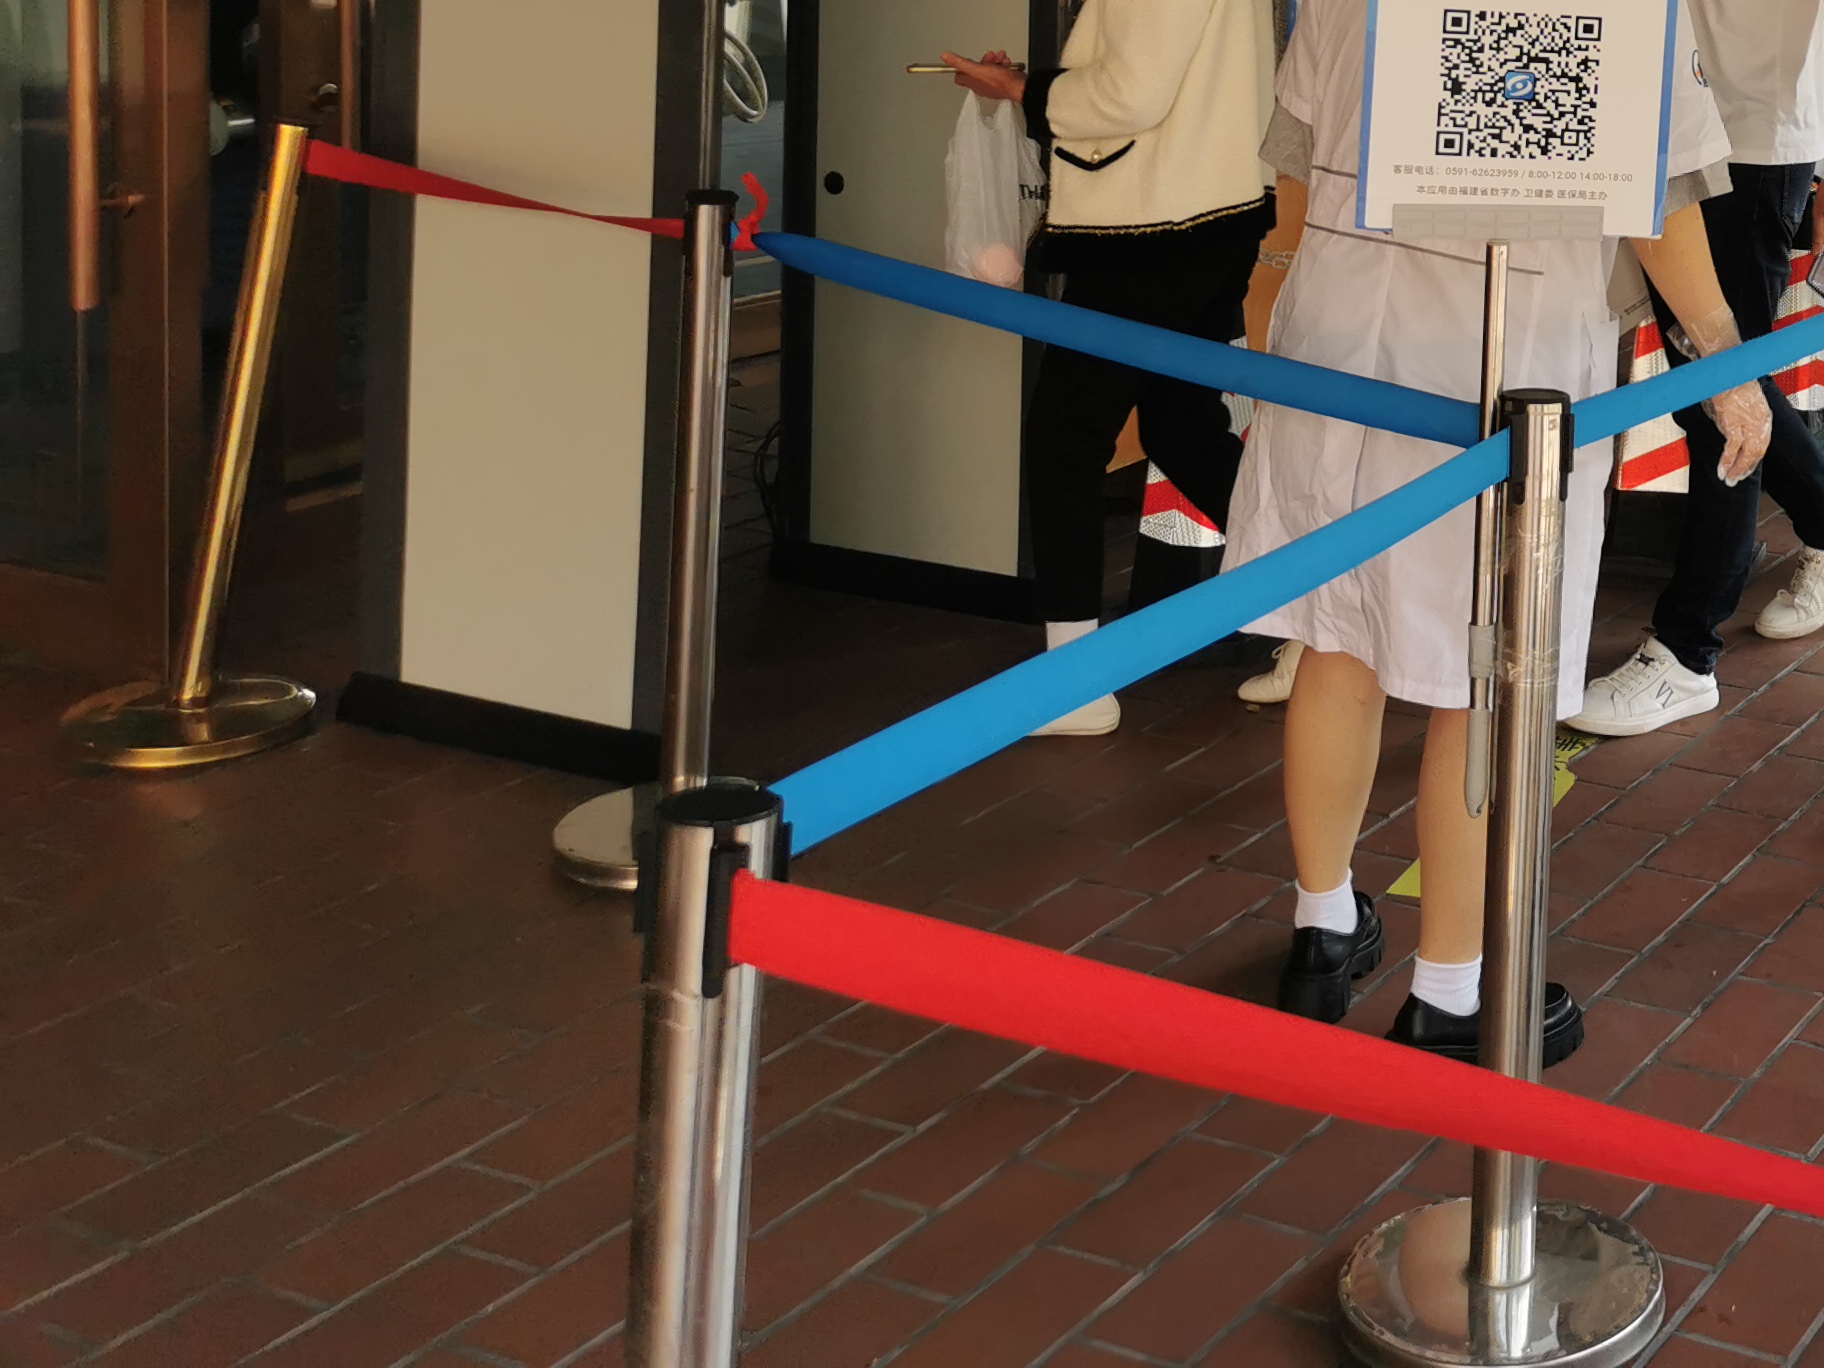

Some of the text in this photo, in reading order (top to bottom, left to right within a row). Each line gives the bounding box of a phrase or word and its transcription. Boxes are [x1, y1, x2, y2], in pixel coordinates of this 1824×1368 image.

[1445, 166, 1519, 179] 0591-62623959
[1528, 169, 1577, 181] 8:00-12:00
[1580, 171, 1633, 183] 14:00-18:00
[1416, 184, 1608, 201] 本应用由福建省数字办 卫健委 医保局主办
